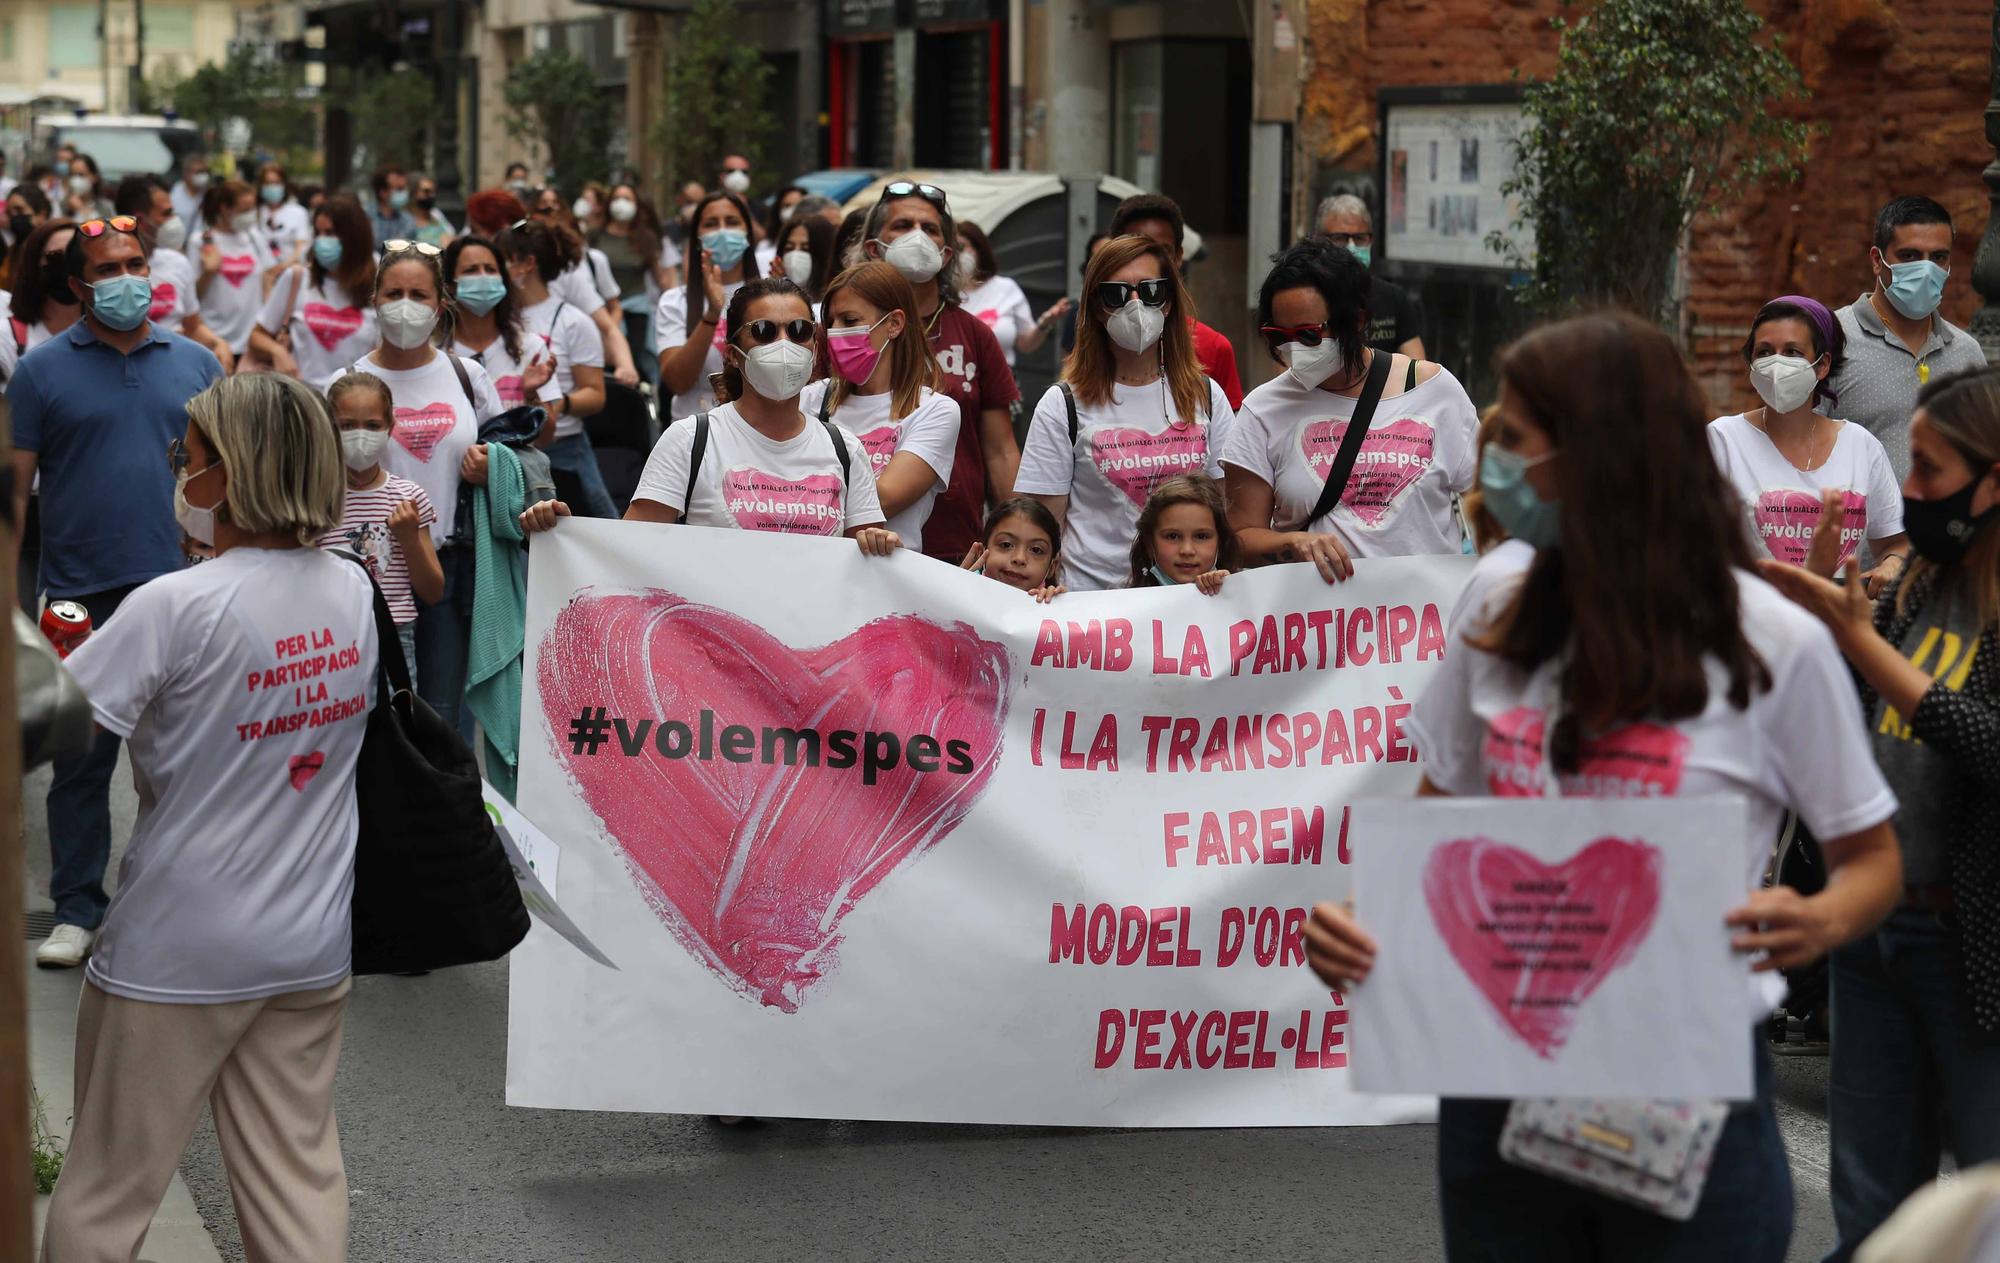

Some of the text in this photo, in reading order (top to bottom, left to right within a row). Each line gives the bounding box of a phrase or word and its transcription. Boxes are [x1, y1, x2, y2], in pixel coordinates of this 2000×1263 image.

[1100, 442, 1126, 450] VOLEM
[1158, 438, 1170, 446] NO
[1312, 435, 1342, 444] VOLEM
[1378, 432, 1391, 440] NO
[1099, 451, 1209, 473] #volemspes
[1309, 450, 1431, 469] #vemspes
[732, 482, 759, 491] VOLEM
[795, 483, 807, 492] NO
[728, 498, 846, 520] #volemspes
[1765, 505, 1791, 513] VOLEM
[756, 521, 779, 529] Volem
[1760, 521, 1865, 545] #volepes
[276, 628, 334, 660] PER LA
[1030, 617, 1134, 672] AMB
[1152, 618, 1212, 678] LA
[247, 640, 361, 692] PARTICIPACIÓ
[296, 682, 329, 707] I LA
[236, 692, 367, 743] TRANSPARÈNCIA
[1031, 686, 1427, 773] I LA TRANSPARÈ
[567, 706, 975, 785] #volemspes
[1163, 805, 1325, 868] FAREM
[1048, 902, 1316, 968] MODEL D'OR
